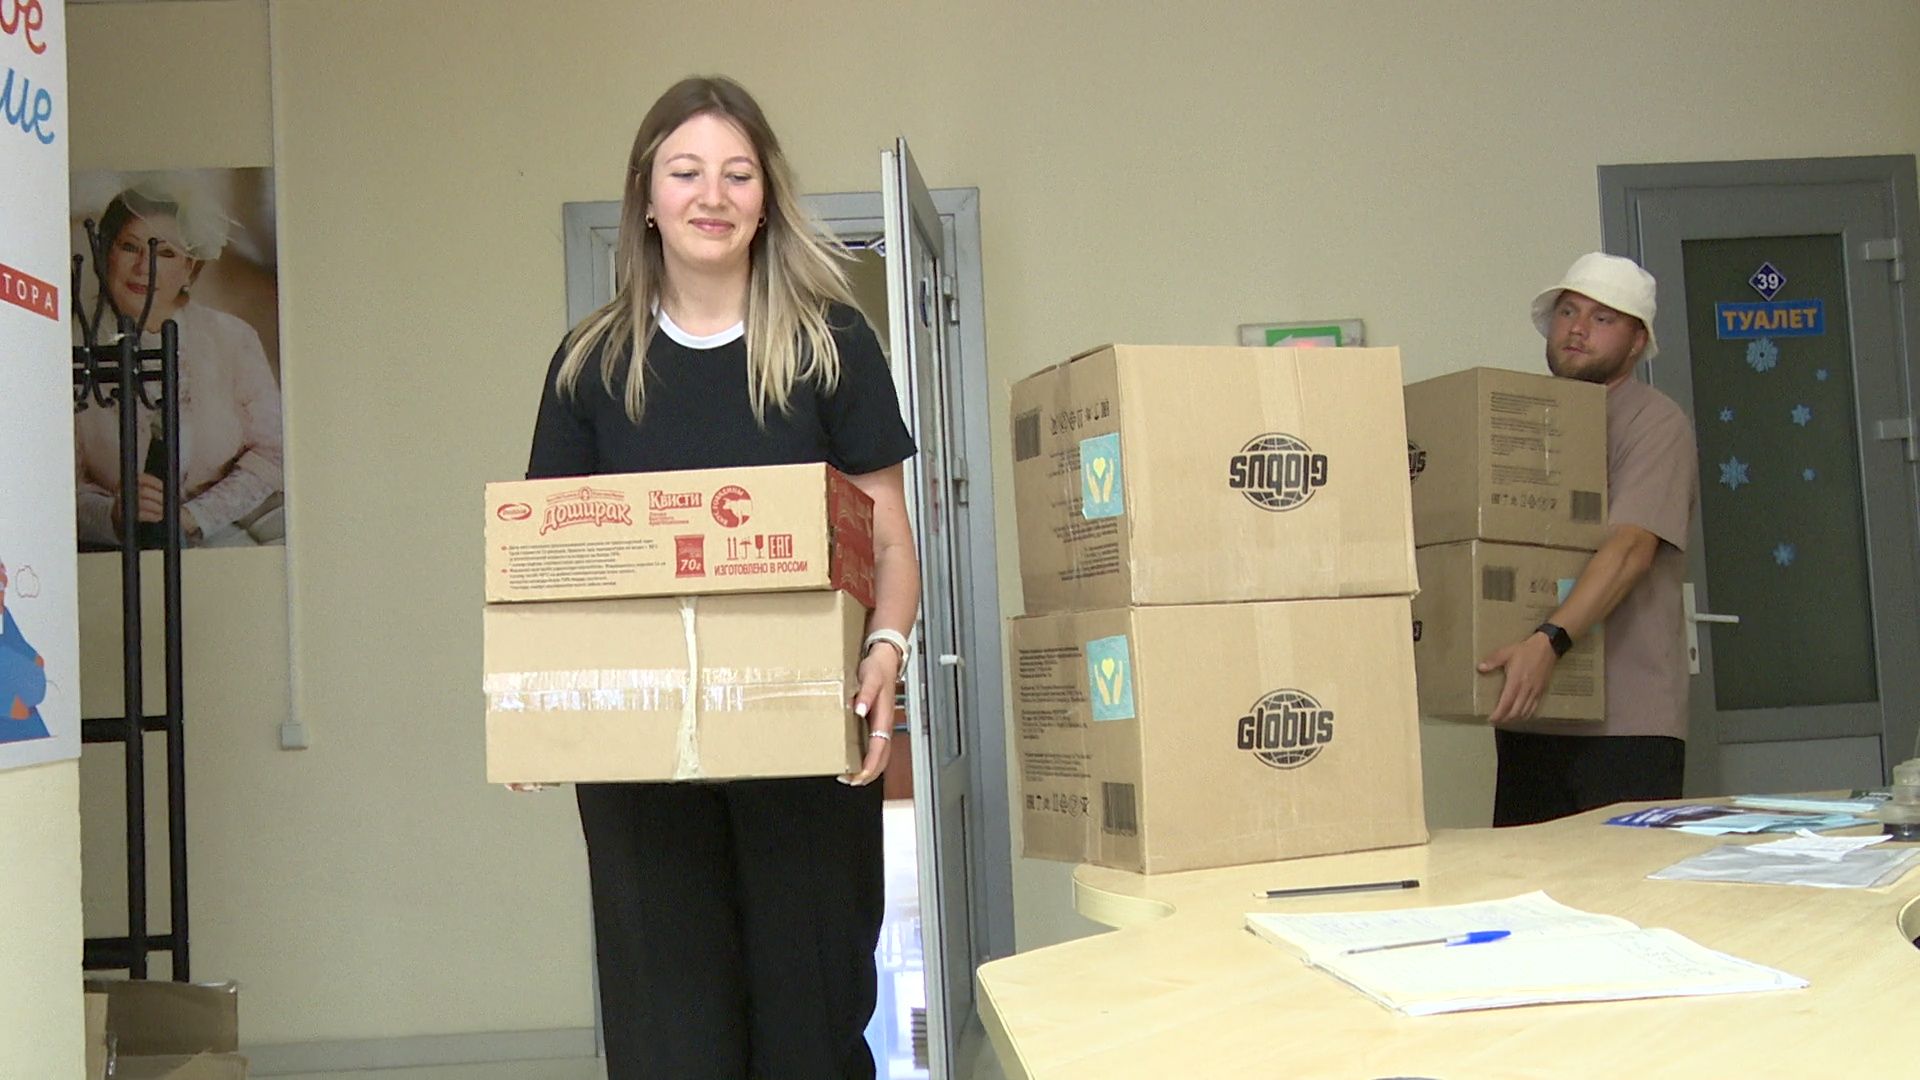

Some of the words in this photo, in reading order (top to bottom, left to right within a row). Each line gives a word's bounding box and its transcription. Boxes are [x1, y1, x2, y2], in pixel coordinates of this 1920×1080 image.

[2, 272, 54, 312] ТОРА
[1757, 273, 1780, 290] 39
[1722, 307, 1818, 331] ТУАЛЕТ
[714, 562, 768, 576] ИЗГОТОВЛЕНО
[770, 562, 776, 574] В
[777, 560, 808, 573] РОССИИ
[1237, 702, 1335, 751] Globus
